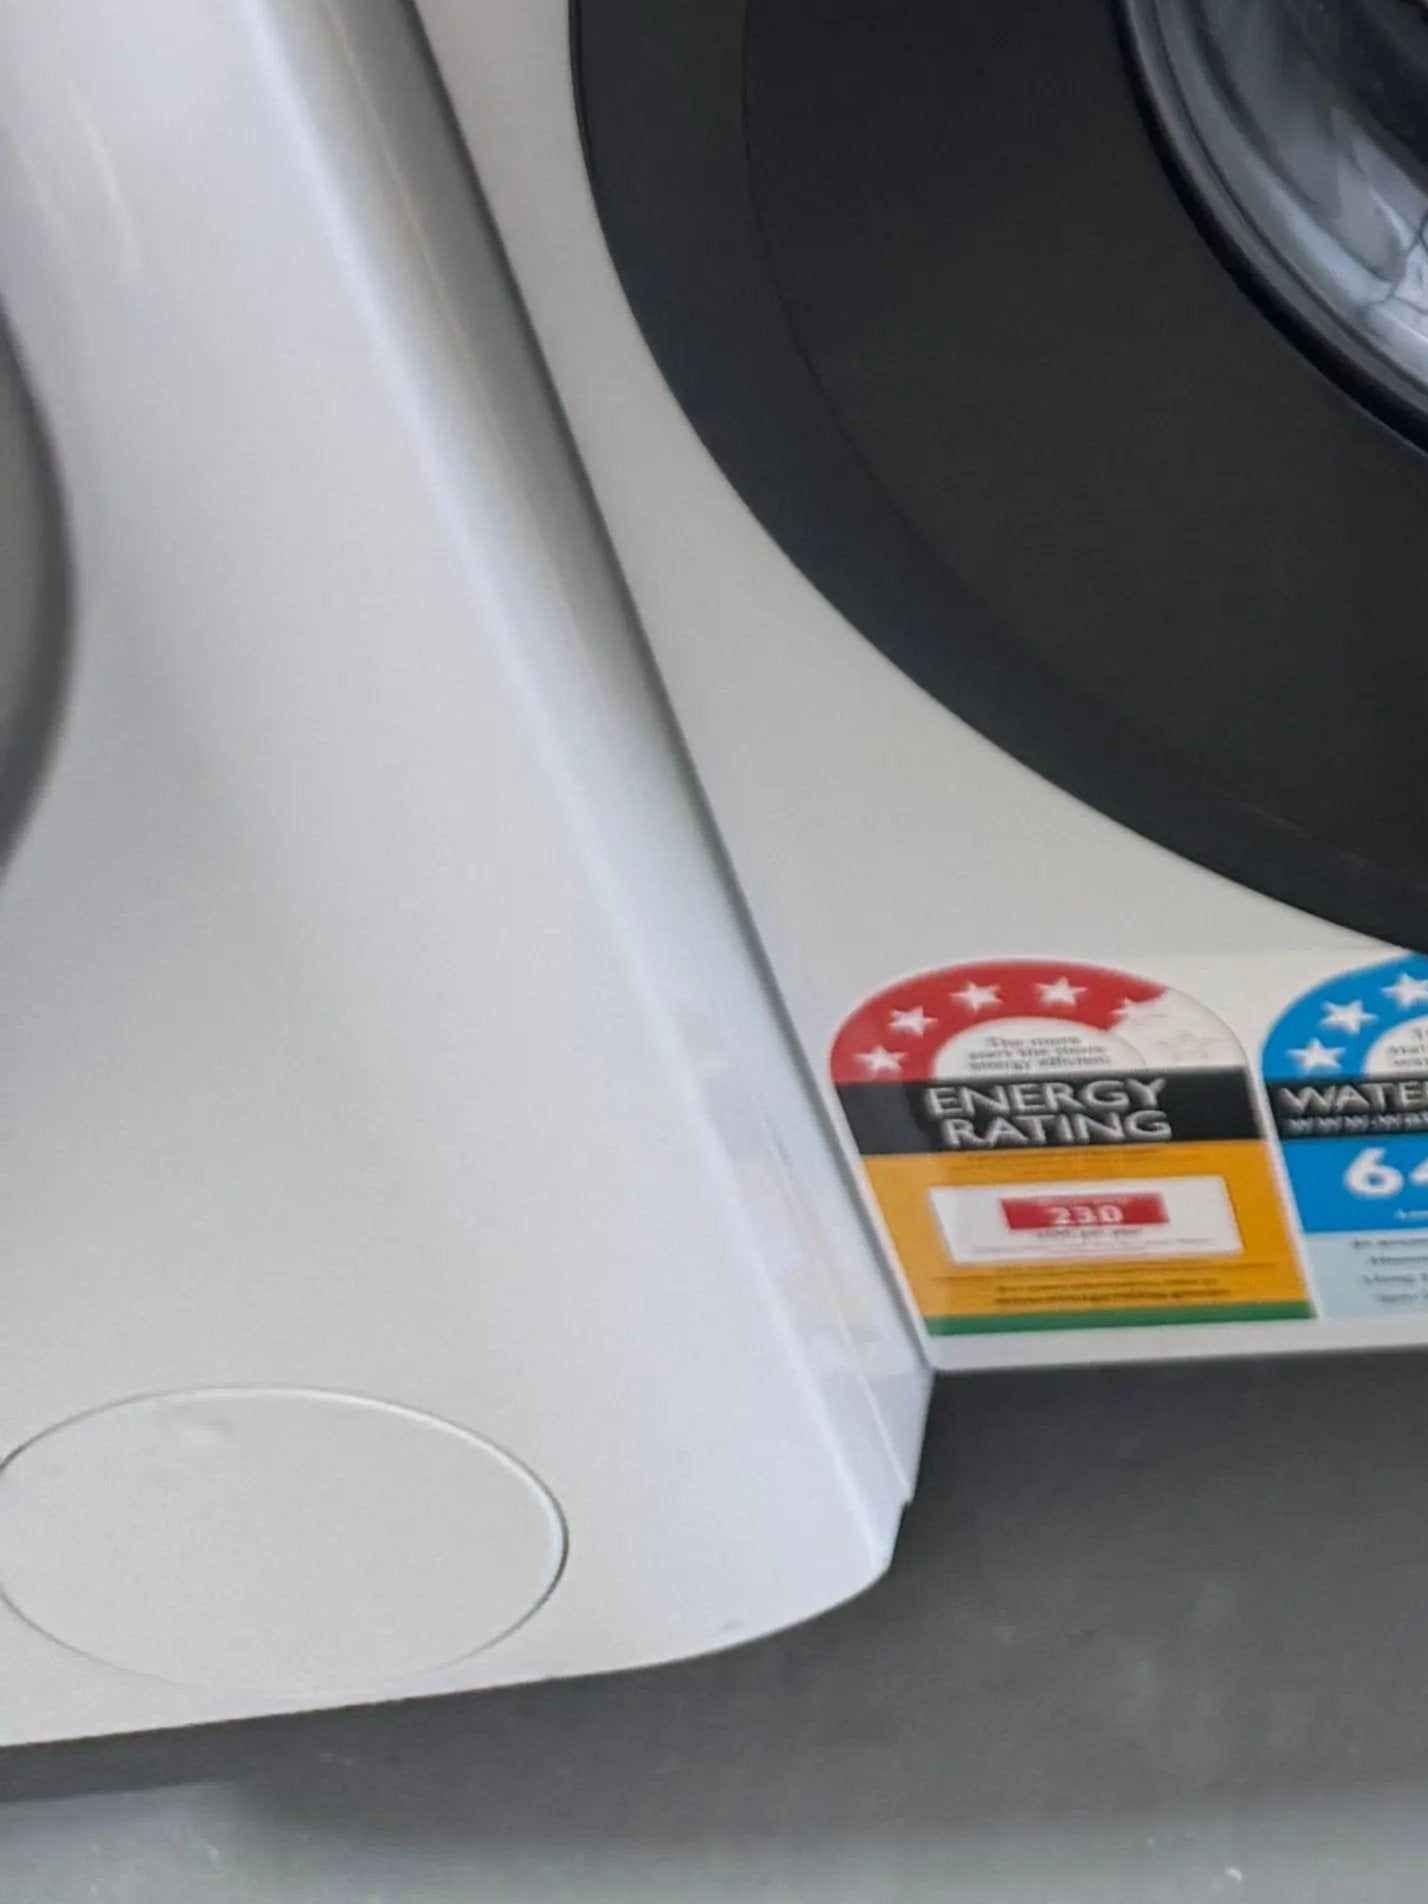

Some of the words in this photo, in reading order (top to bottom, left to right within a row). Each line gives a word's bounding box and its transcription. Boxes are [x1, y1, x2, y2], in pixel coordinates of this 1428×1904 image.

[926, 1077, 1166, 1117] ENERGY
[941, 1109, 1171, 1148] RATING
[1050, 1204, 1123, 1224] 230
